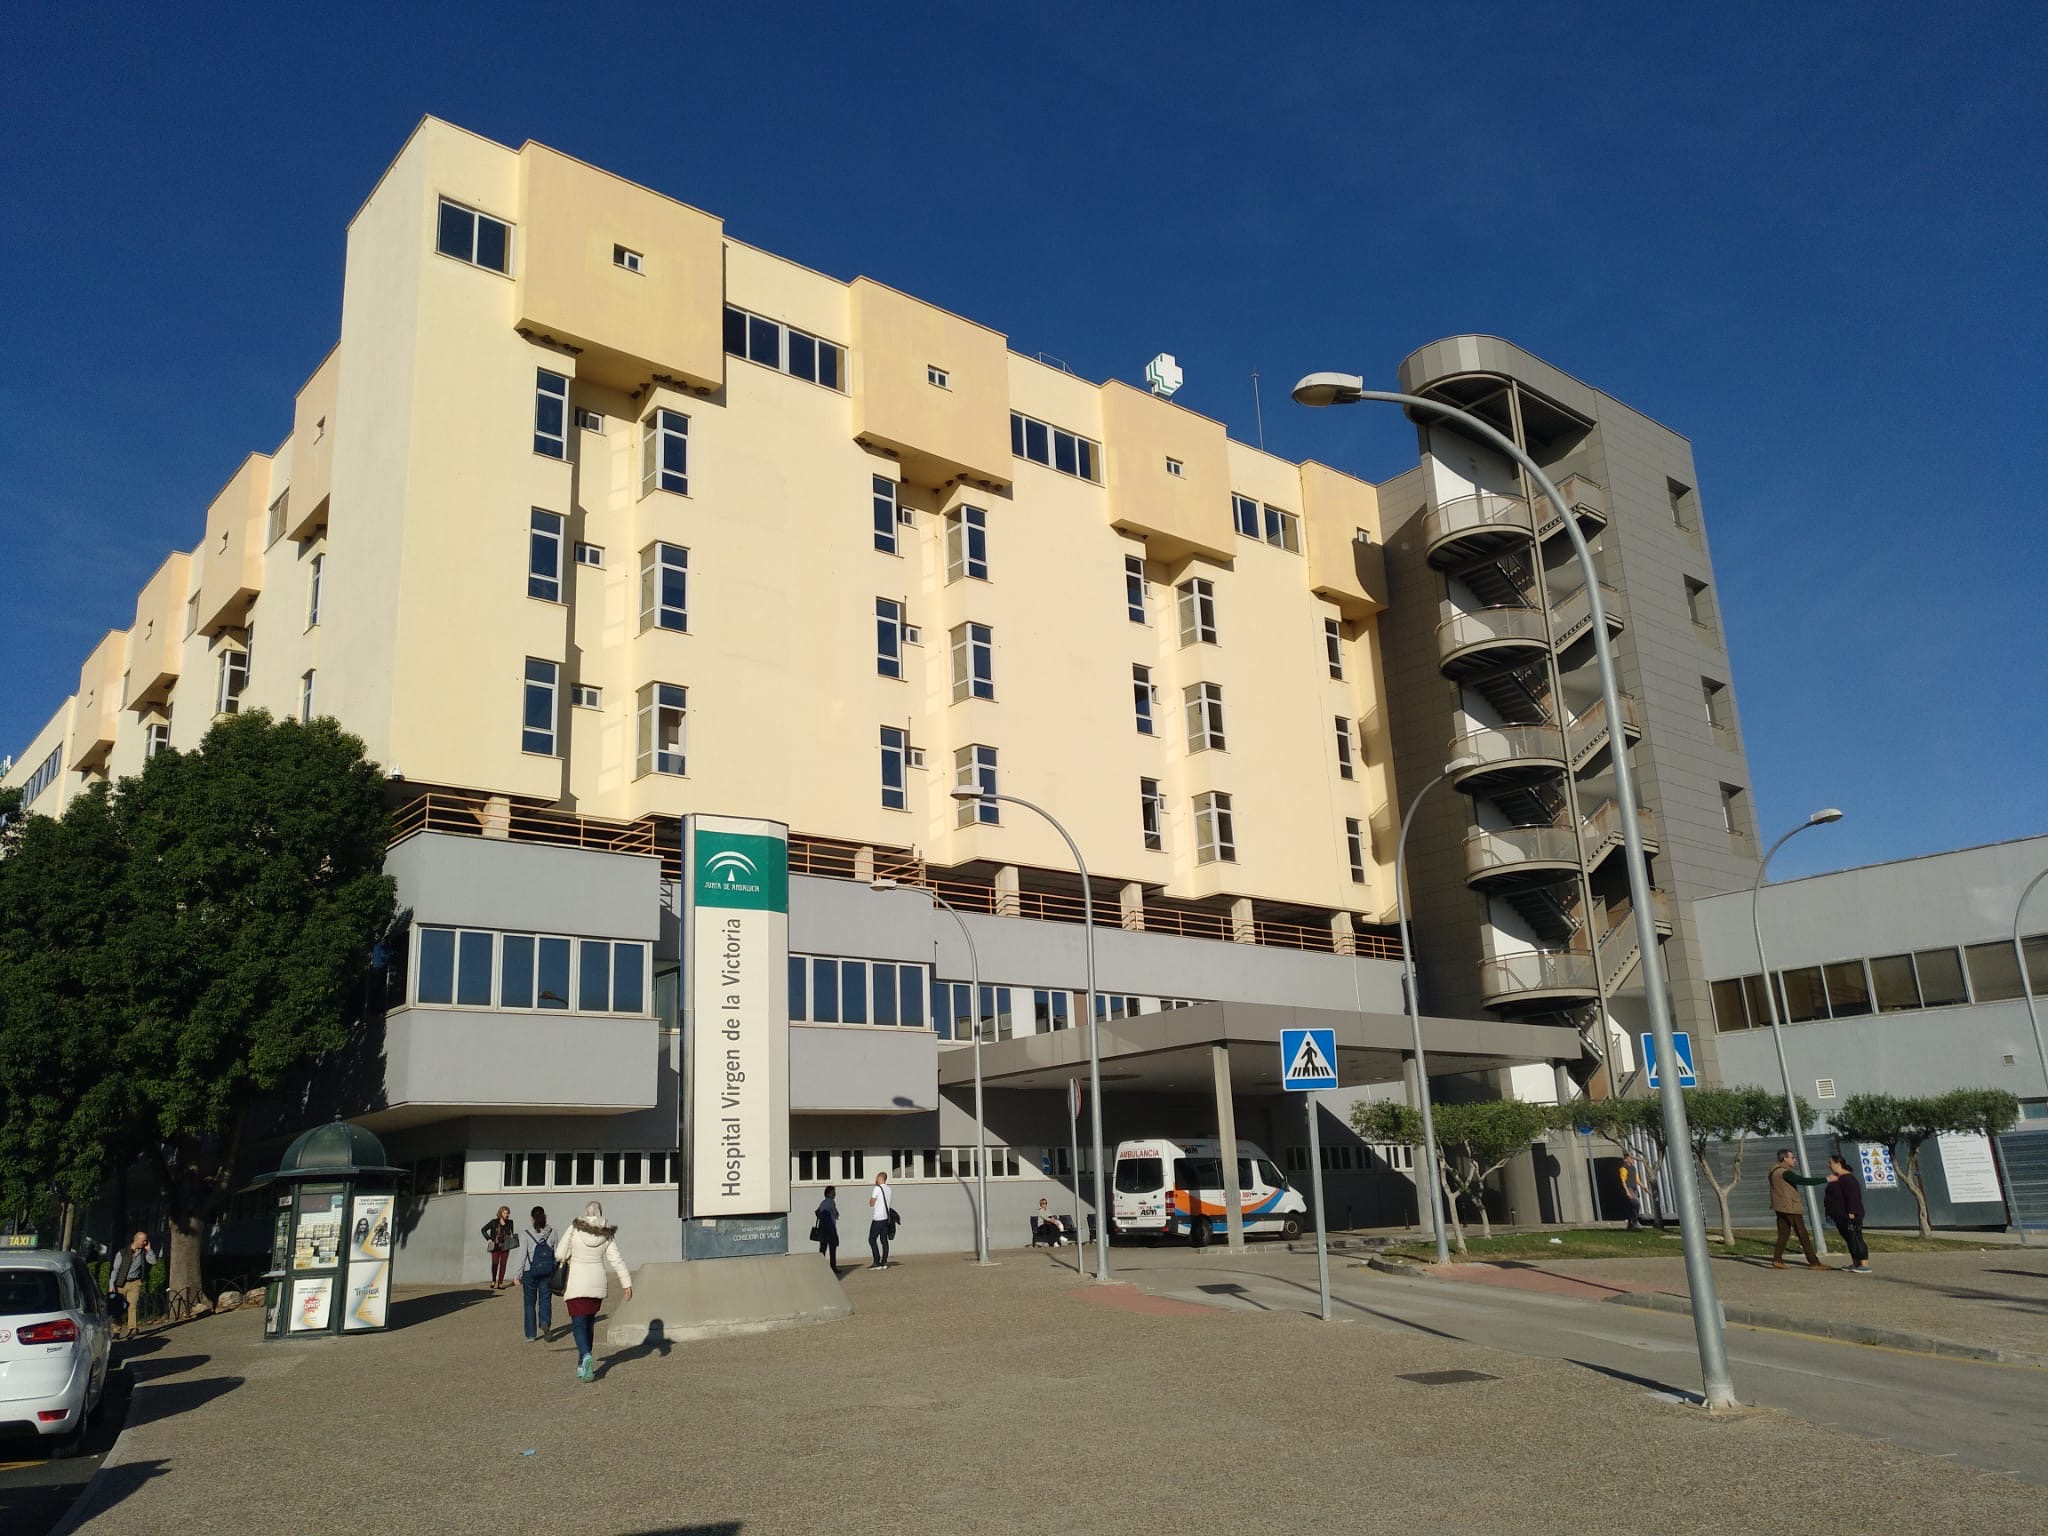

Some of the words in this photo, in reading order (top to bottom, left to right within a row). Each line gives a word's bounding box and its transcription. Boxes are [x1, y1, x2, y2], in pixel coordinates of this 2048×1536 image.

[704, 881, 722, 890] JUNTA
[723, 883, 731, 891] DE
[721, 919, 741, 987] Victoria
[721, 995, 741, 1010] la
[721, 1018, 741, 1040] de
[720, 1049, 746, 1109] Virgen
[721, 1118, 746, 1197] Hospital
[1119, 1149, 1160, 1158] AMBULANCIA
[9, 1236, 29, 1246] TAXI
